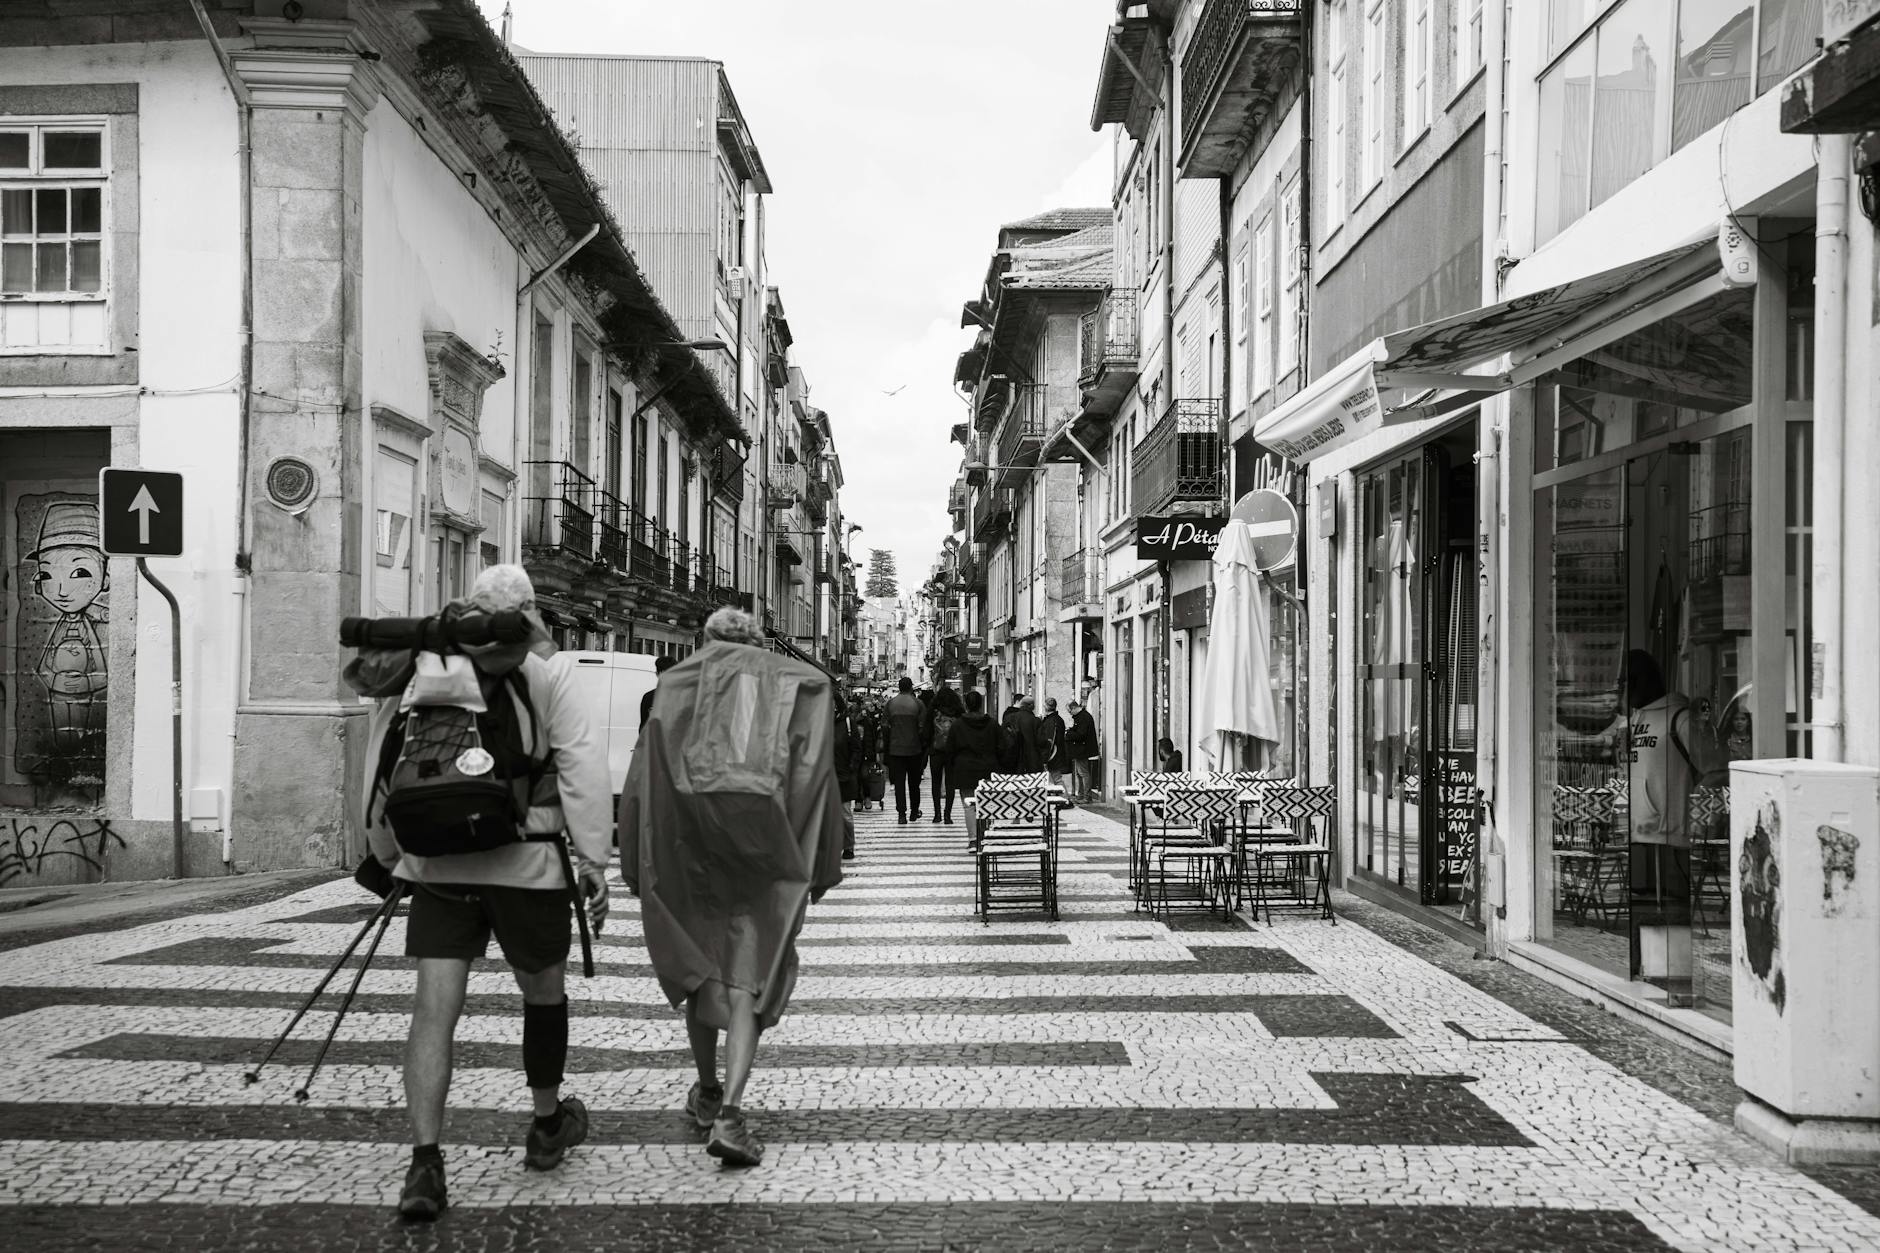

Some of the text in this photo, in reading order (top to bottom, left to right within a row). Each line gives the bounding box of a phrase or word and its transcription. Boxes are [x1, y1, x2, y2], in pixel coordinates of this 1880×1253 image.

[1142, 522, 1226, 551] A Pétal
[1207, 545, 1219, 553] NO
[1451, 771, 1475, 784] HAV
[1447, 785, 1475, 805] BEE
[1459, 832, 1475, 845] YO
